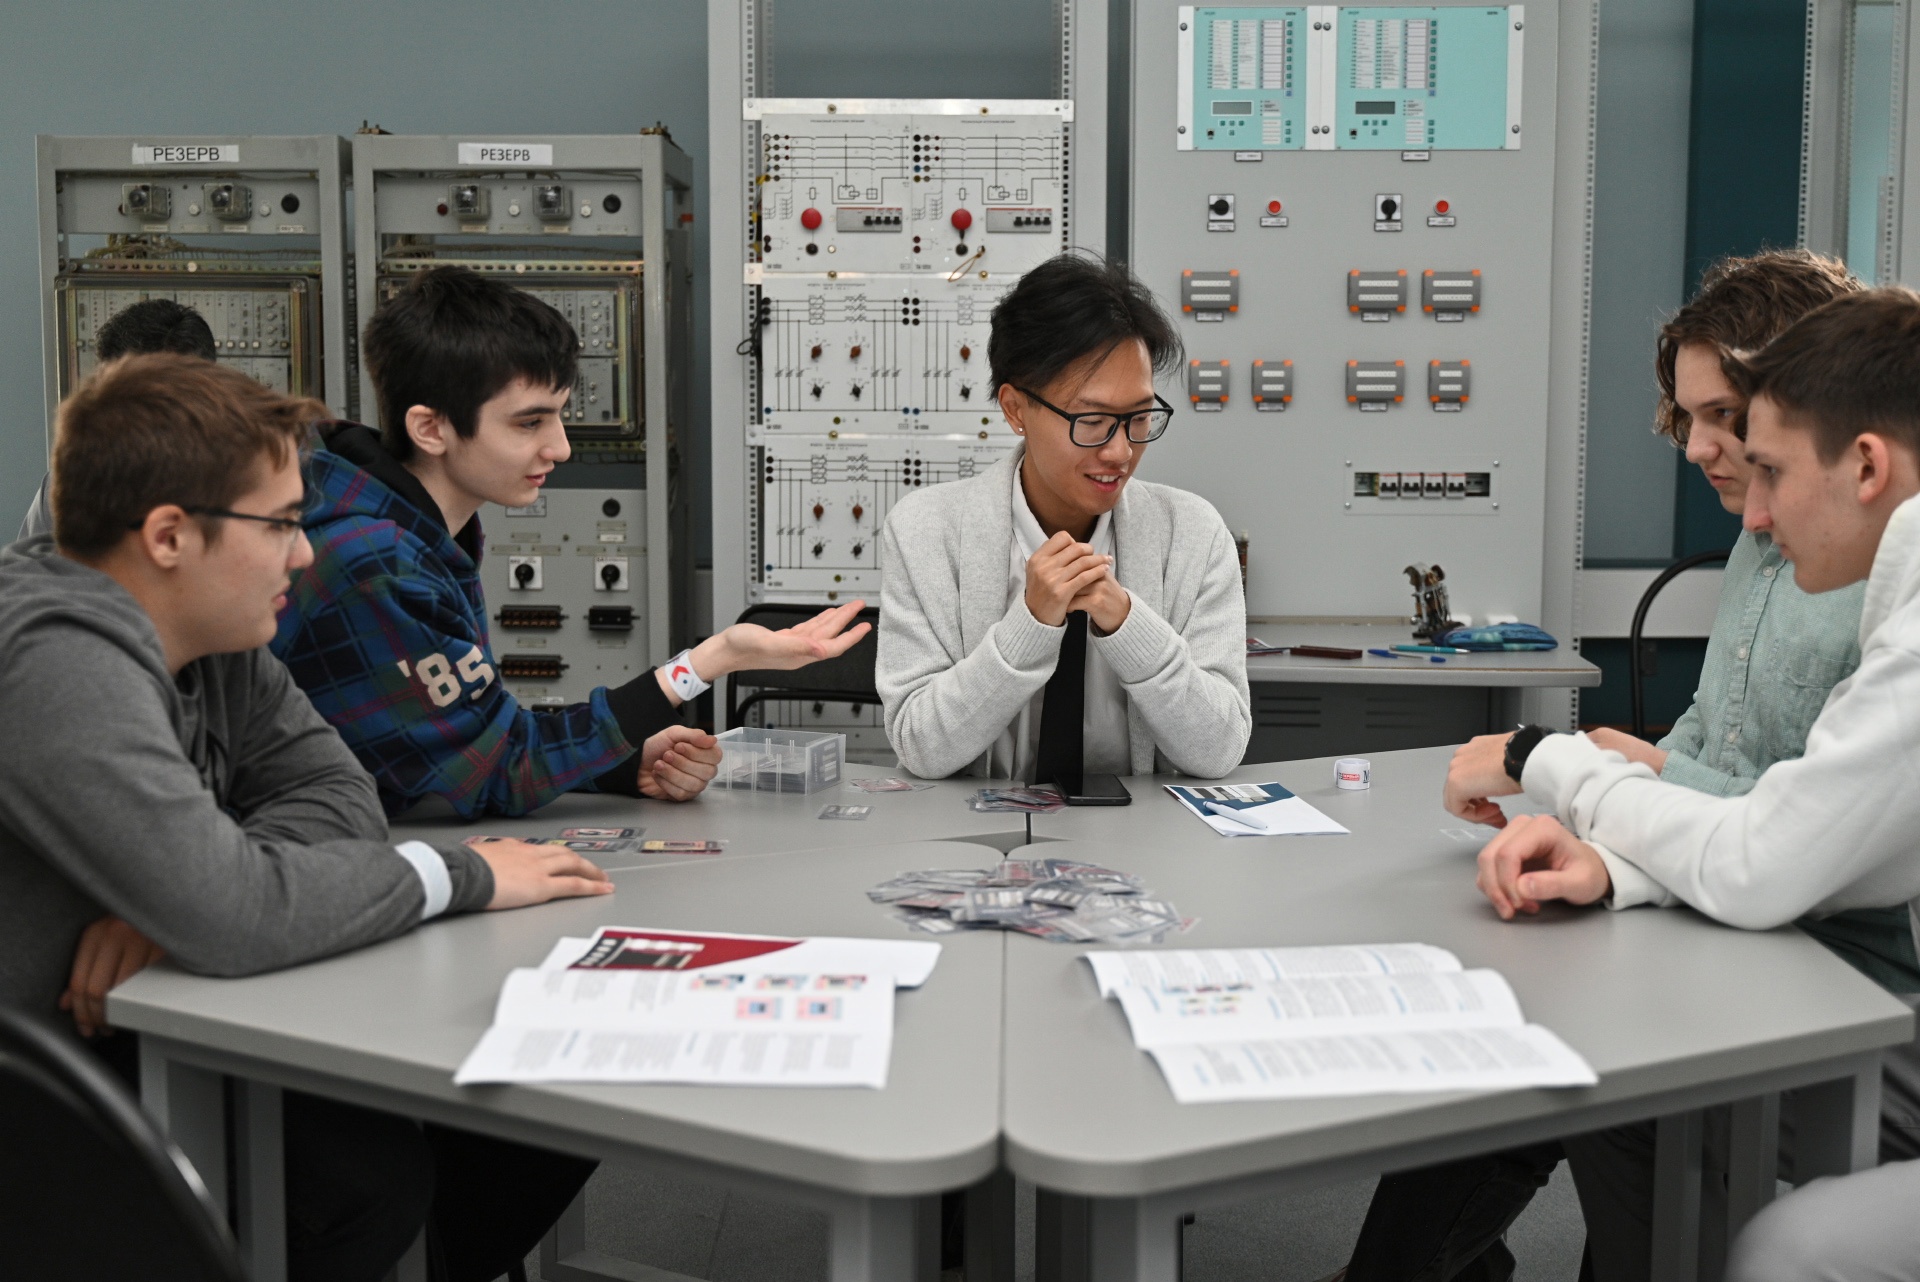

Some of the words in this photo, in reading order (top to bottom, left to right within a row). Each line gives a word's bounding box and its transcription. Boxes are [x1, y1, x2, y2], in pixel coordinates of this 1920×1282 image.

[153, 147, 220, 162] РЕЗЕРВ
[480, 149, 531, 162] РЕЗЕРВ
[396, 645, 495, 707] '85
